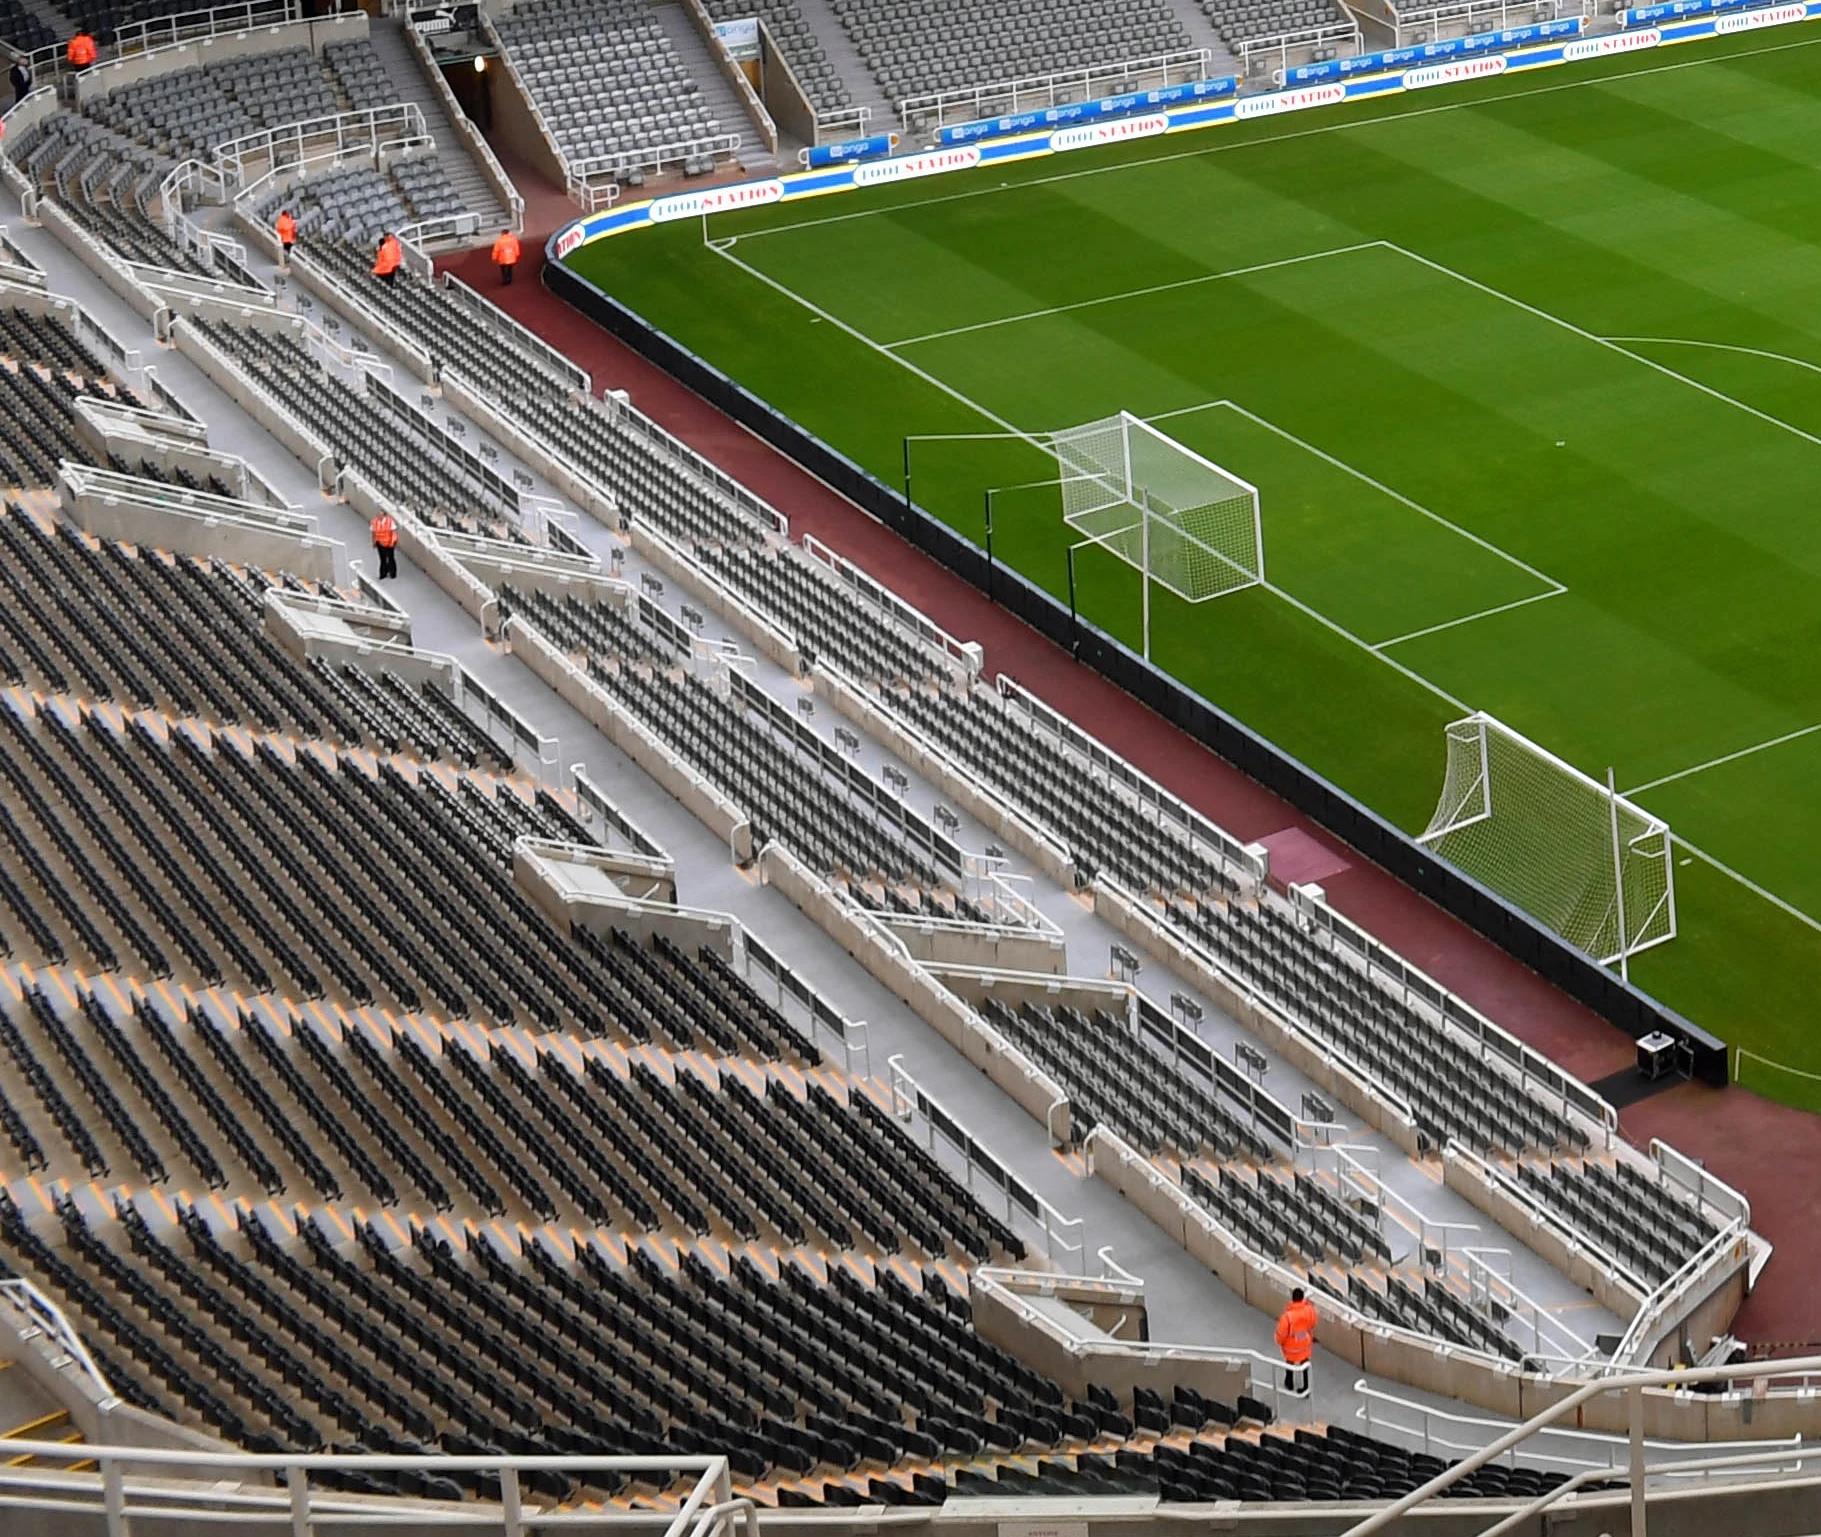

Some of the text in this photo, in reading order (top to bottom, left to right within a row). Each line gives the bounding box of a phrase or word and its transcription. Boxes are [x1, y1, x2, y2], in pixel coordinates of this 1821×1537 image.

[1721, 6, 1803, 30] TOOLSTATION
[1570, 31, 1657, 57] TOOLSTATION
[1409, 58, 1503, 86] TOOLSTATION
[1242, 87, 1341, 114] TOOLSTATION
[1058, 118, 1164, 146] TOOLSTATION
[862, 151, 976, 182] TOOLSTATION
